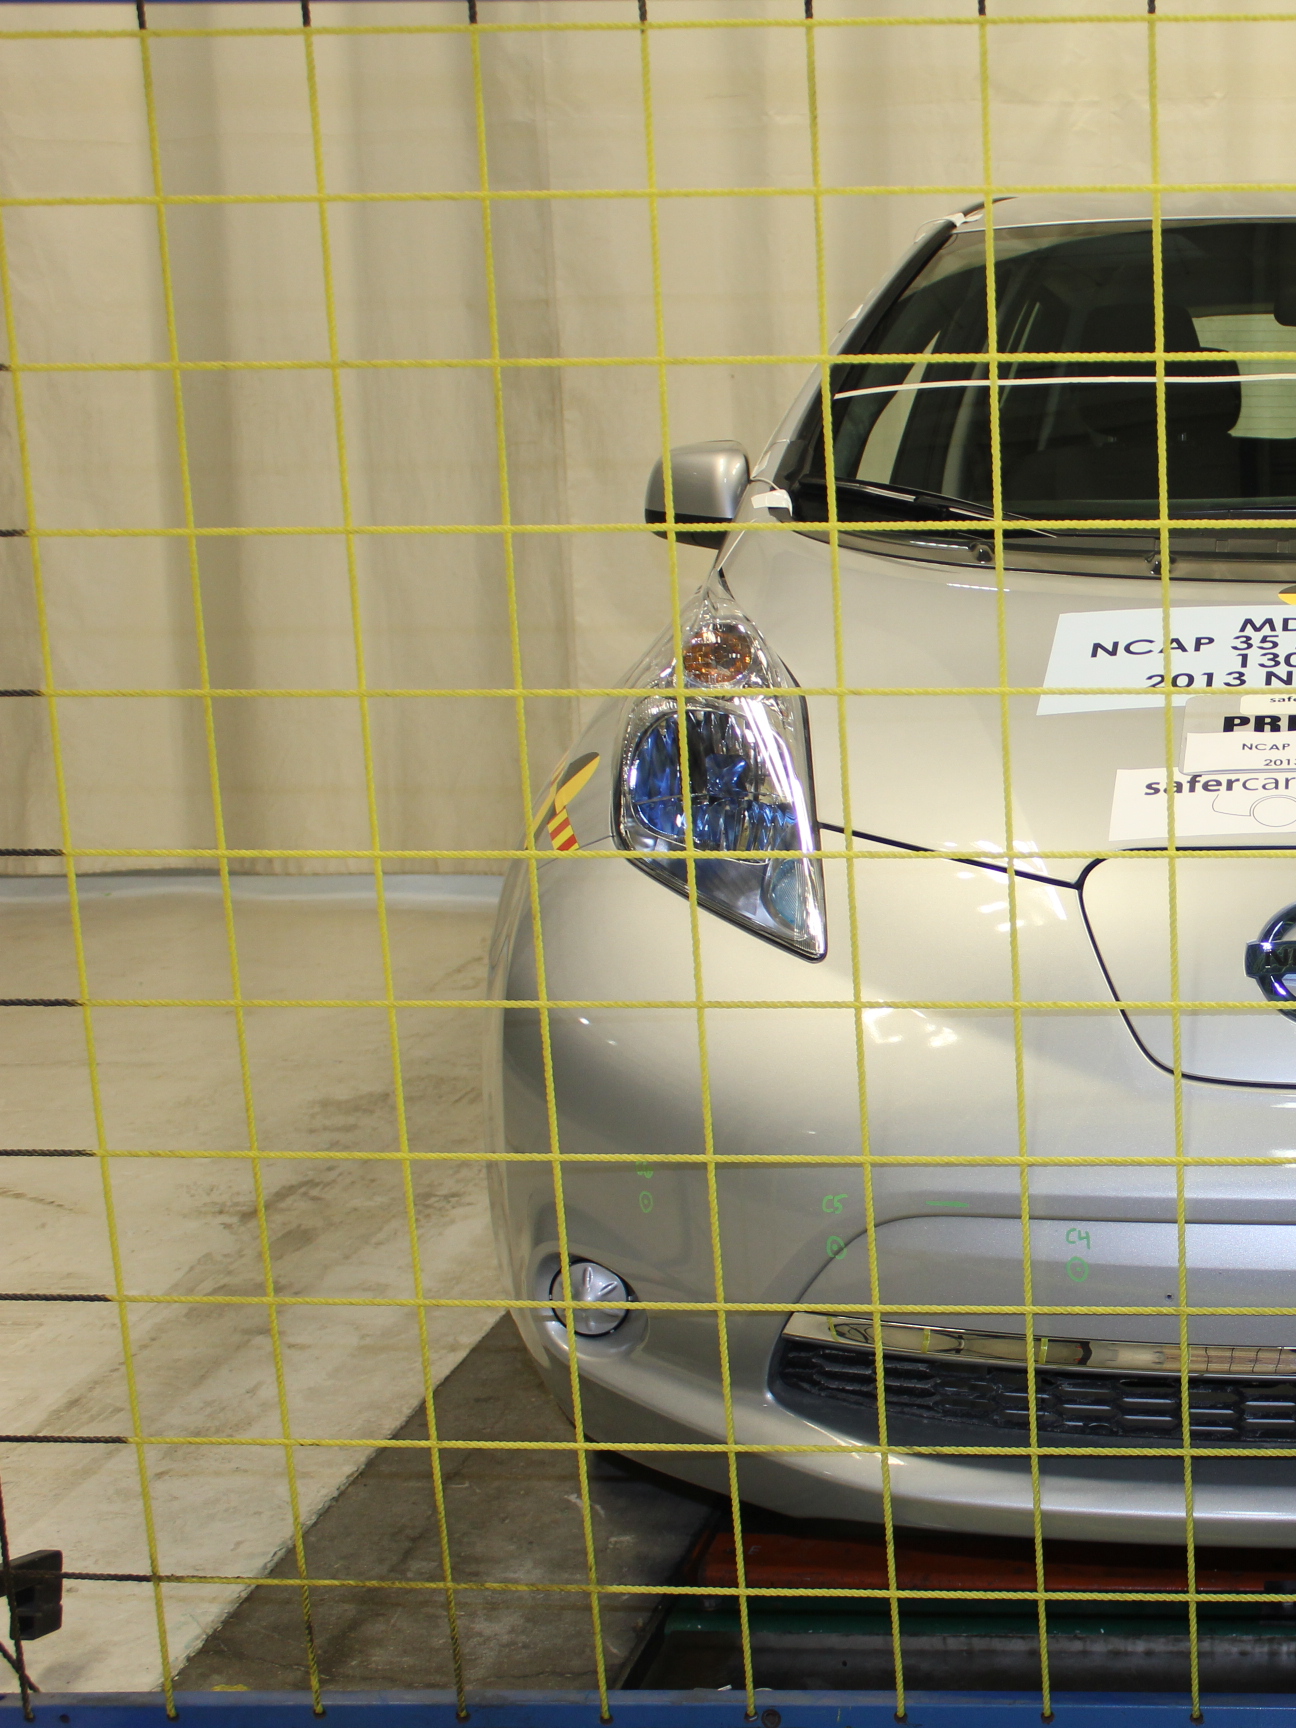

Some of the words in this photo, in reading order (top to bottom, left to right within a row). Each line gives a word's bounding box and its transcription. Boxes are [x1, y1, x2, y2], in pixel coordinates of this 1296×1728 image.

[1090, 636, 1215, 658] NCAP
[1230, 634, 1280, 651] 35
[1145, 670, 1247, 688] 2013
[1241, 743, 1291, 751] NCAP
[821, 1193, 849, 1215] C5
[1065, 1227, 1091, 1250] C4
